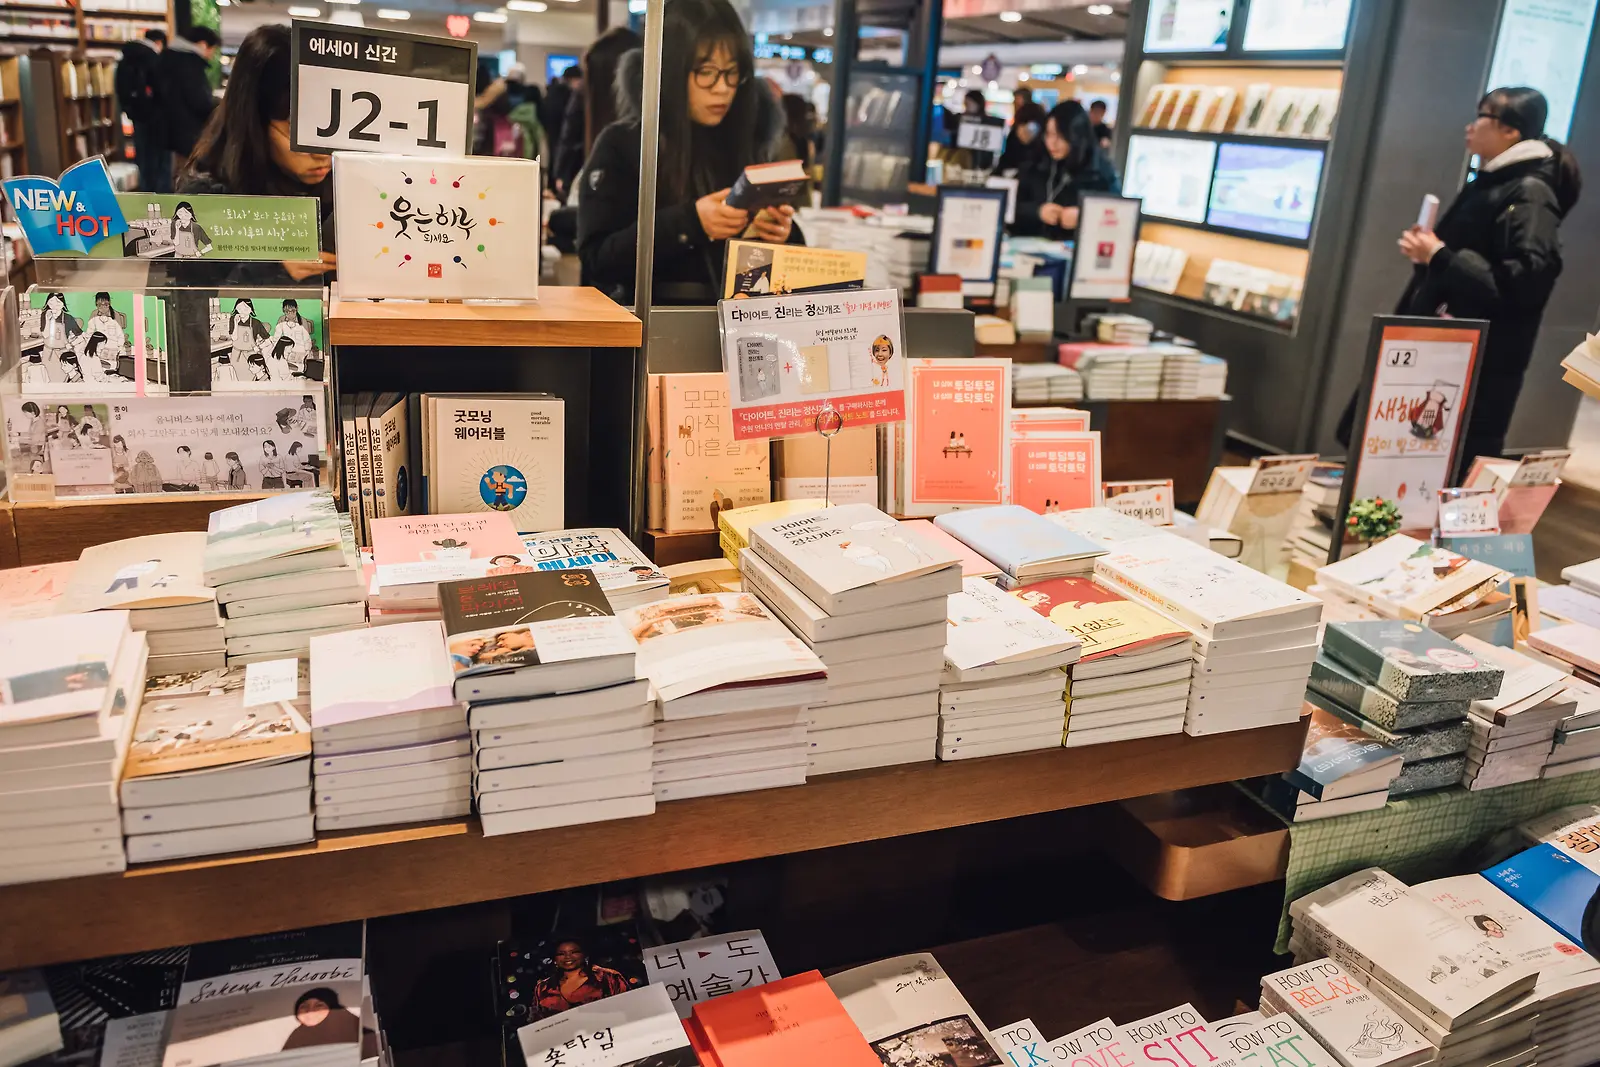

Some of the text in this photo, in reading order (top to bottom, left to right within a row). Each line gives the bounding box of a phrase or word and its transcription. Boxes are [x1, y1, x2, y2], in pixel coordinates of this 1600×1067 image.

[309, 37, 398, 64] 에세이 신간
[316, 88, 447, 149] J2-1
[57, 214, 112, 238] HOT
[731, 309, 772, 322] 다이어트,
[774, 305, 803, 319] 진리는
[805, 303, 841, 317] 정신개조
[954, 379, 995, 392] 투덜투덜
[684, 390, 728, 409] 모모
[954, 392, 994, 404] 토닥토닥
[156, 413, 243, 425] 옴니버스 퇴사 에세이
[454, 410, 492, 423] 굿모닝
[778, 408, 802, 418] 진리는
[127, 426, 273, 438] 회사 그만두고 어떻게 보내셨어요?
[684, 414, 720, 433] 아직
[454, 427, 506, 440] 웨어러블
[345, 433, 358, 489] 굿모닝 웨어러블
[358, 428, 371, 484] 굿모닝 웨어러블
[371, 428, 384, 484] 굿모닝 웨어러블
[1048, 451, 1086, 462] 투덜투덜
[1048, 463, 1086, 473] 토닥토닥
[772, 516, 829, 533] 다이어트,
[782, 525, 823, 539] 진리는
[791, 528, 845, 546] 정신개조
[230, 953, 319, 971] Refugee Education
[654, 937, 760, 971] 너 도
[665, 965, 770, 1002] 예술가
[1275, 963, 1339, 990] HOW TO
[190, 982, 264, 1005] Sakena
[1289, 976, 1361, 1009] RELAX
[1002, 1027, 1032, 1046] TO
[1126, 1011, 1196, 1044] HOW TO
[1264, 1021, 1292, 1039] TO
[1052, 1027, 1113, 1060] OW TO
[1143, 1025, 1219, 1067] SIT
[1007, 1042, 1049, 1067] LK
